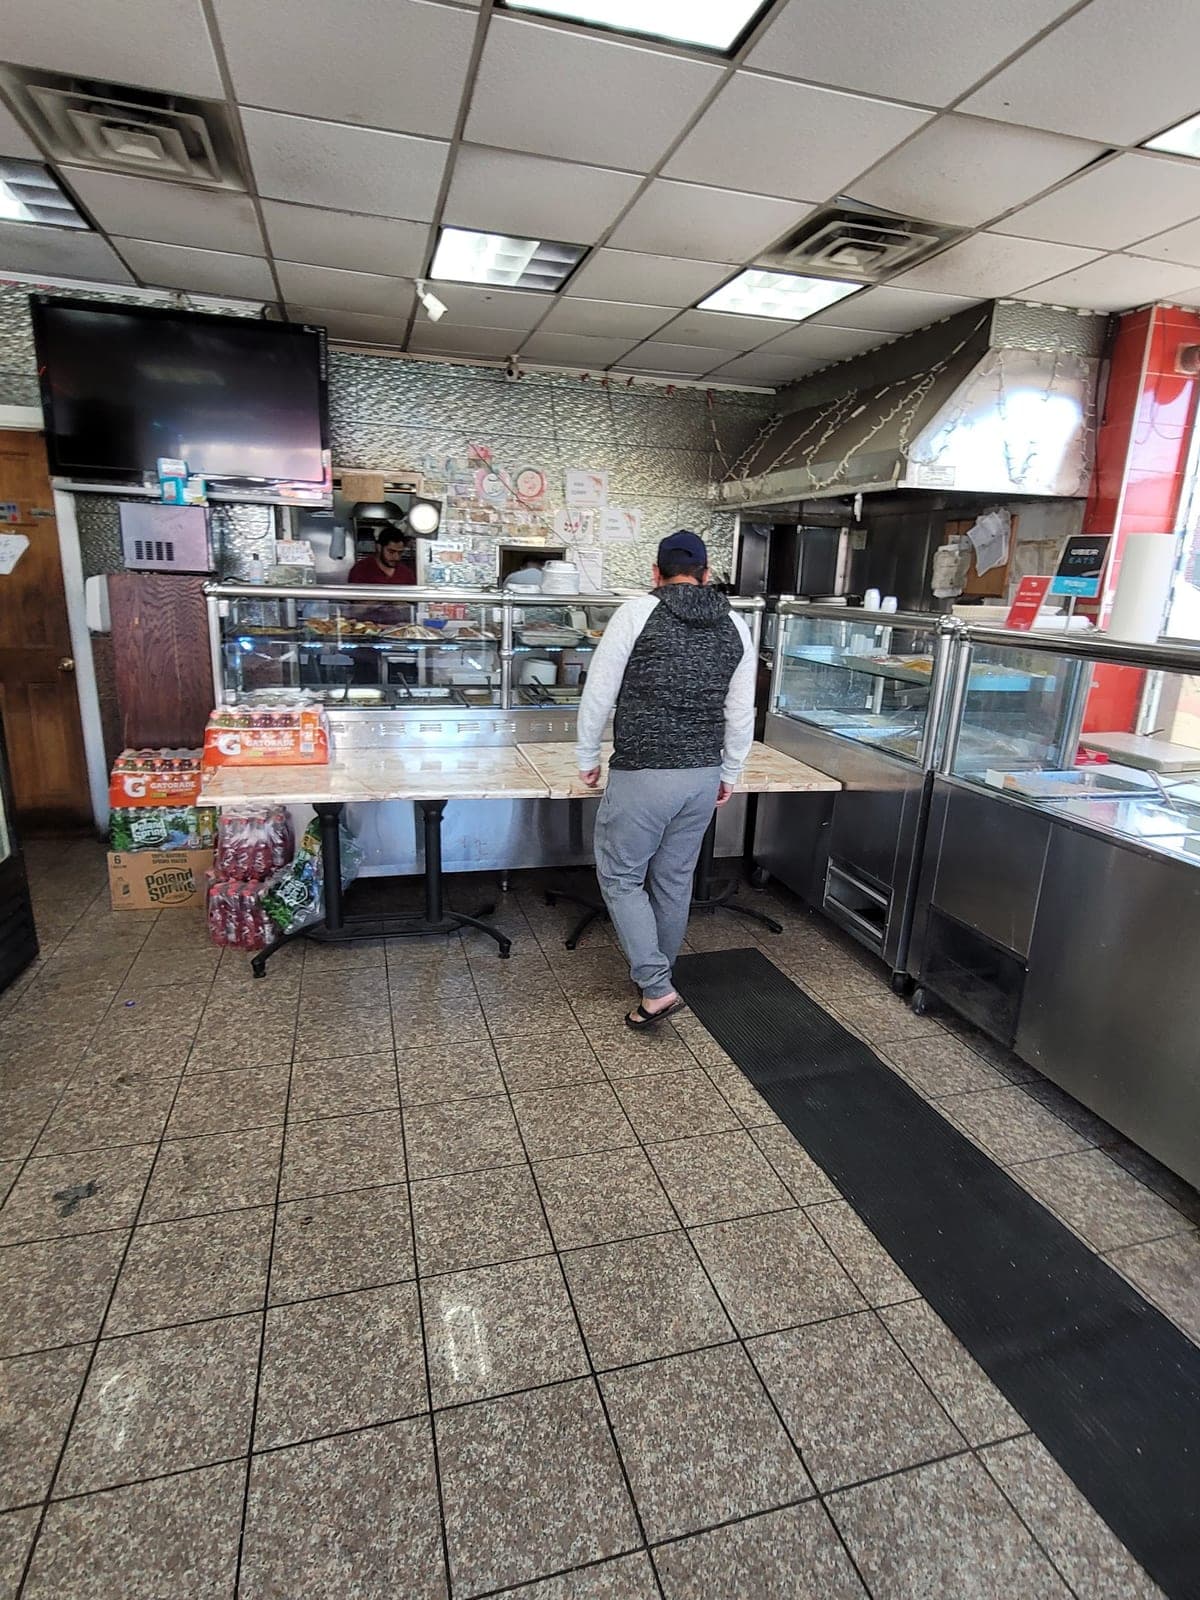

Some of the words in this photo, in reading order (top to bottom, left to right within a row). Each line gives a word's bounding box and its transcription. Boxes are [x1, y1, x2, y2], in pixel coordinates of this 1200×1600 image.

[217, 733, 241, 755] G
[245, 738, 295, 747] GATORADE
[123, 776, 147, 797] G
[150, 781, 197, 789] GATORADE
[131, 819, 164, 834] Poland
[114, 855, 121, 864] 6
[145, 867, 193, 889] Poland
[149, 880, 197, 901] Spring
